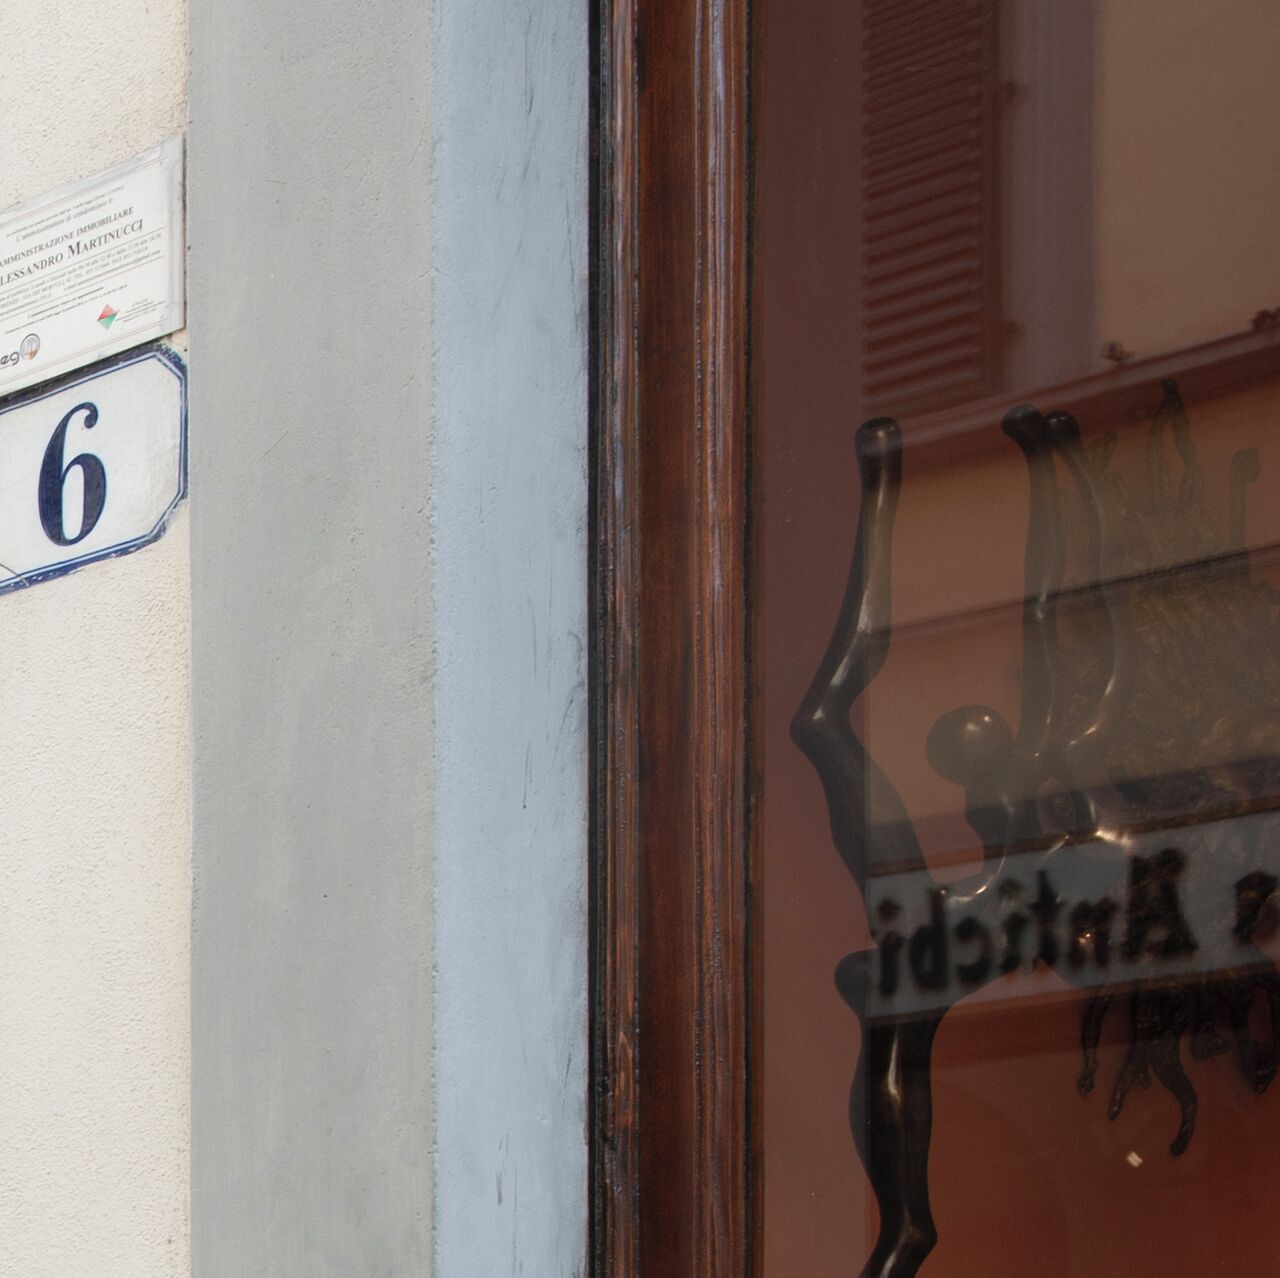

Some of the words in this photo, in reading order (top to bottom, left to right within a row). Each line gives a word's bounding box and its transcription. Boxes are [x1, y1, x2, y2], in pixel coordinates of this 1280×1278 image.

[67, 219, 144, 260] MARTINUCCI
[76, 206, 134, 236] IMMOBILIARE
[38, 402, 107, 546] 6
